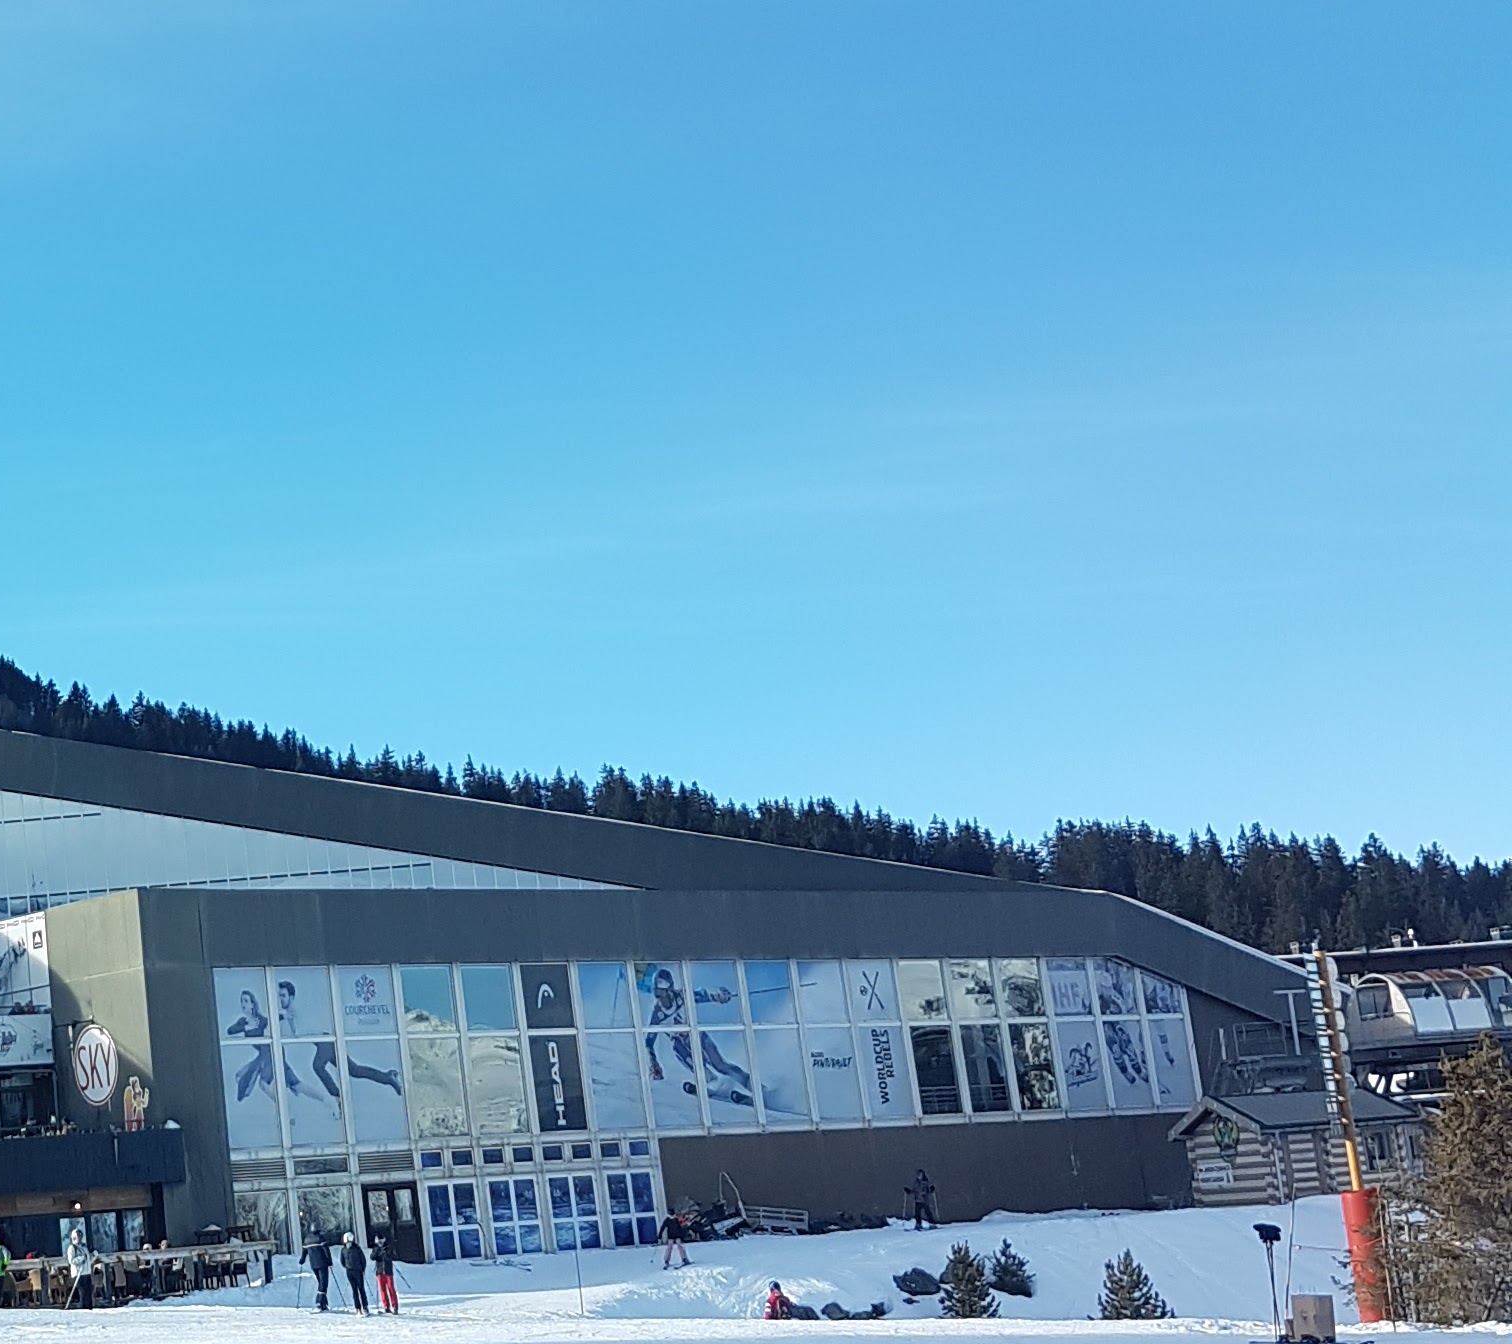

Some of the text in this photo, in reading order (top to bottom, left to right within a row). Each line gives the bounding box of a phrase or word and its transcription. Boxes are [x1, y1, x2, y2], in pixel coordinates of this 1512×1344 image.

[77, 1042, 115, 1093] SKY
[546, 1041, 567, 1126] HEAD
[871, 1028, 890, 1105] WORLDCUP
[879, 1030, 895, 1078] REBELS
